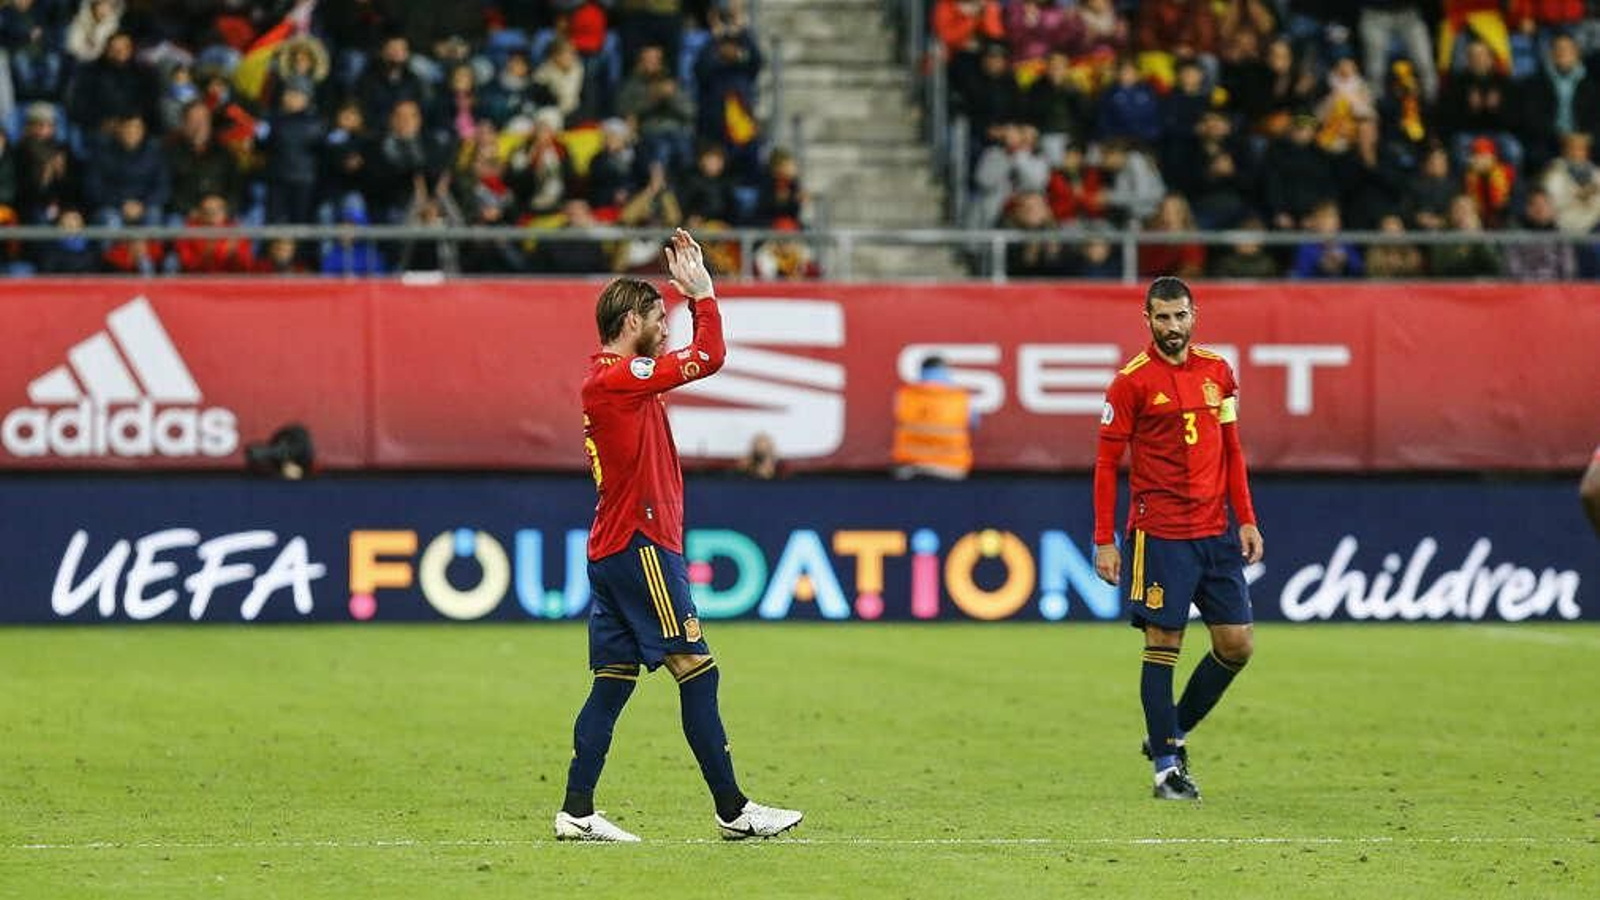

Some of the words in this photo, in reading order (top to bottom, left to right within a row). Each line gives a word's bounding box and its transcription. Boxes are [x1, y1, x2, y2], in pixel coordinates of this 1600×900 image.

[898, 343, 1350, 416] SET
[2, 400, 238, 456] adidas
[1182, 411, 1199, 445] 3
[51, 528, 327, 620] UEFA
[349, 527, 1121, 620] FOUDATION
[1280, 535, 1581, 621] children
